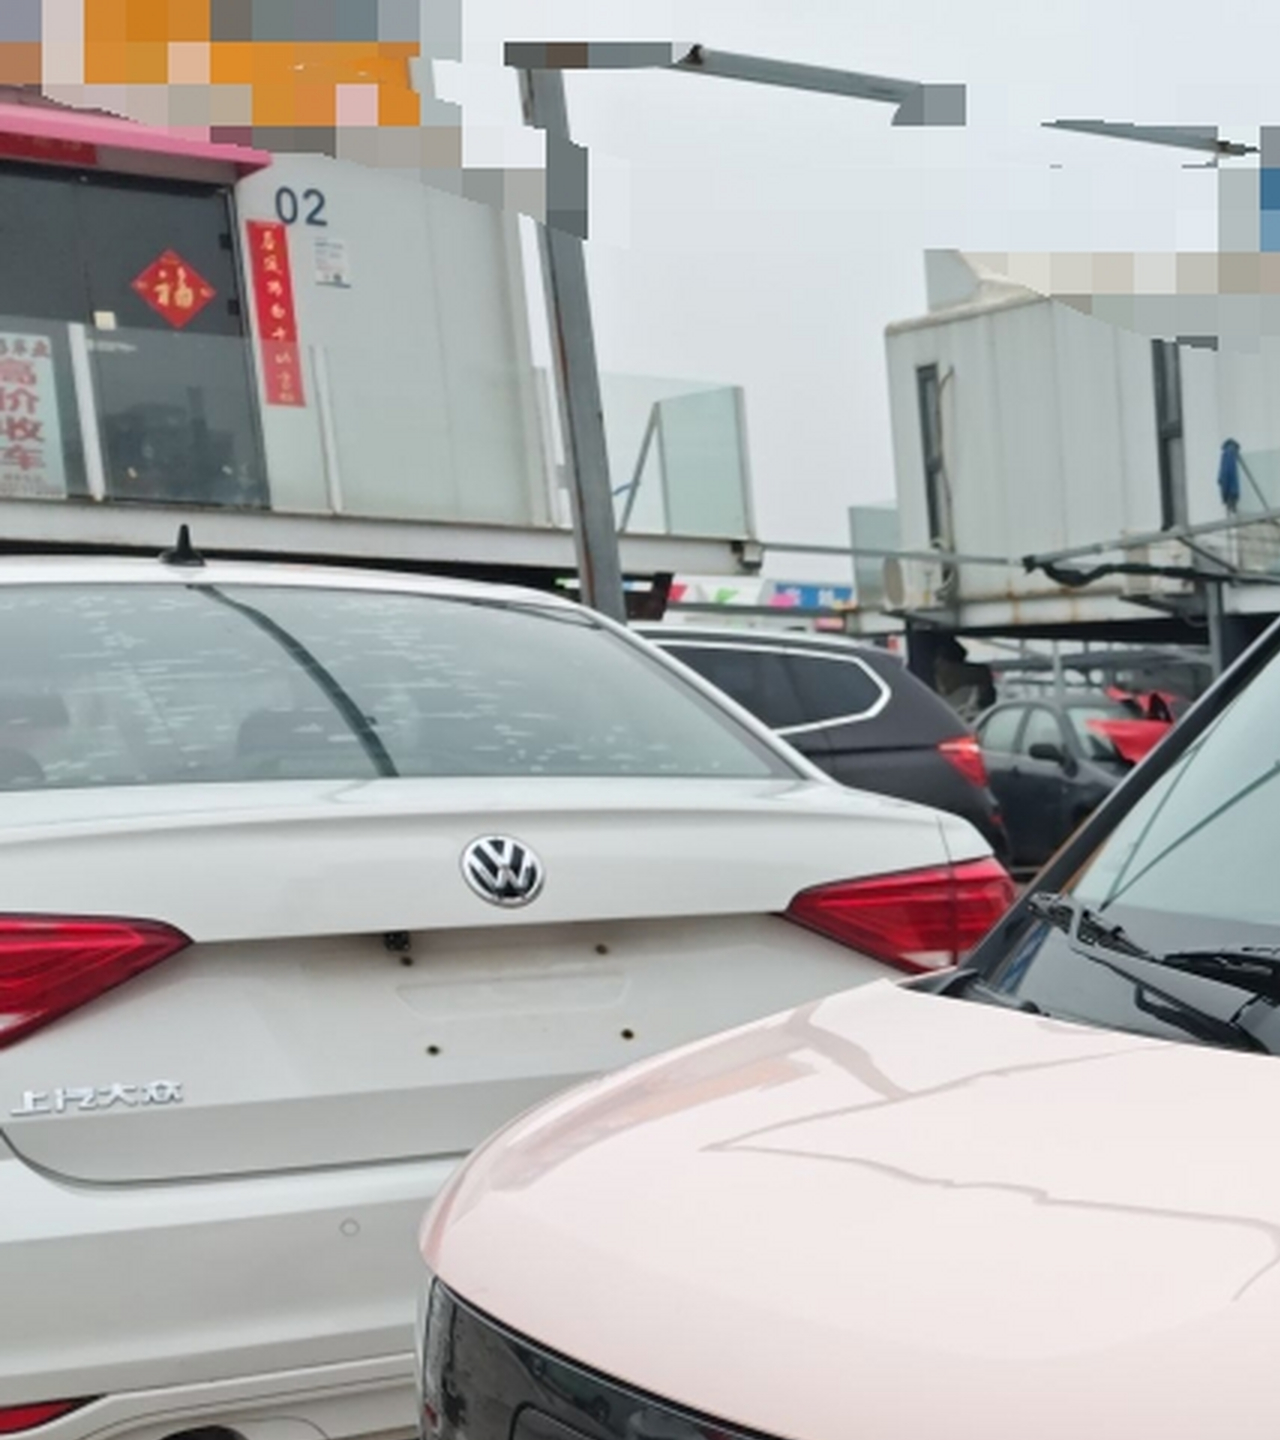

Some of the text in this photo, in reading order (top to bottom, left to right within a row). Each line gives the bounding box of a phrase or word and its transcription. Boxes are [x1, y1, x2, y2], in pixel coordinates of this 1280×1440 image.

[275, 186, 328, 226] 02
[153, 266, 194, 308] 福
[10, 1078, 184, 1117] 上汽大众
